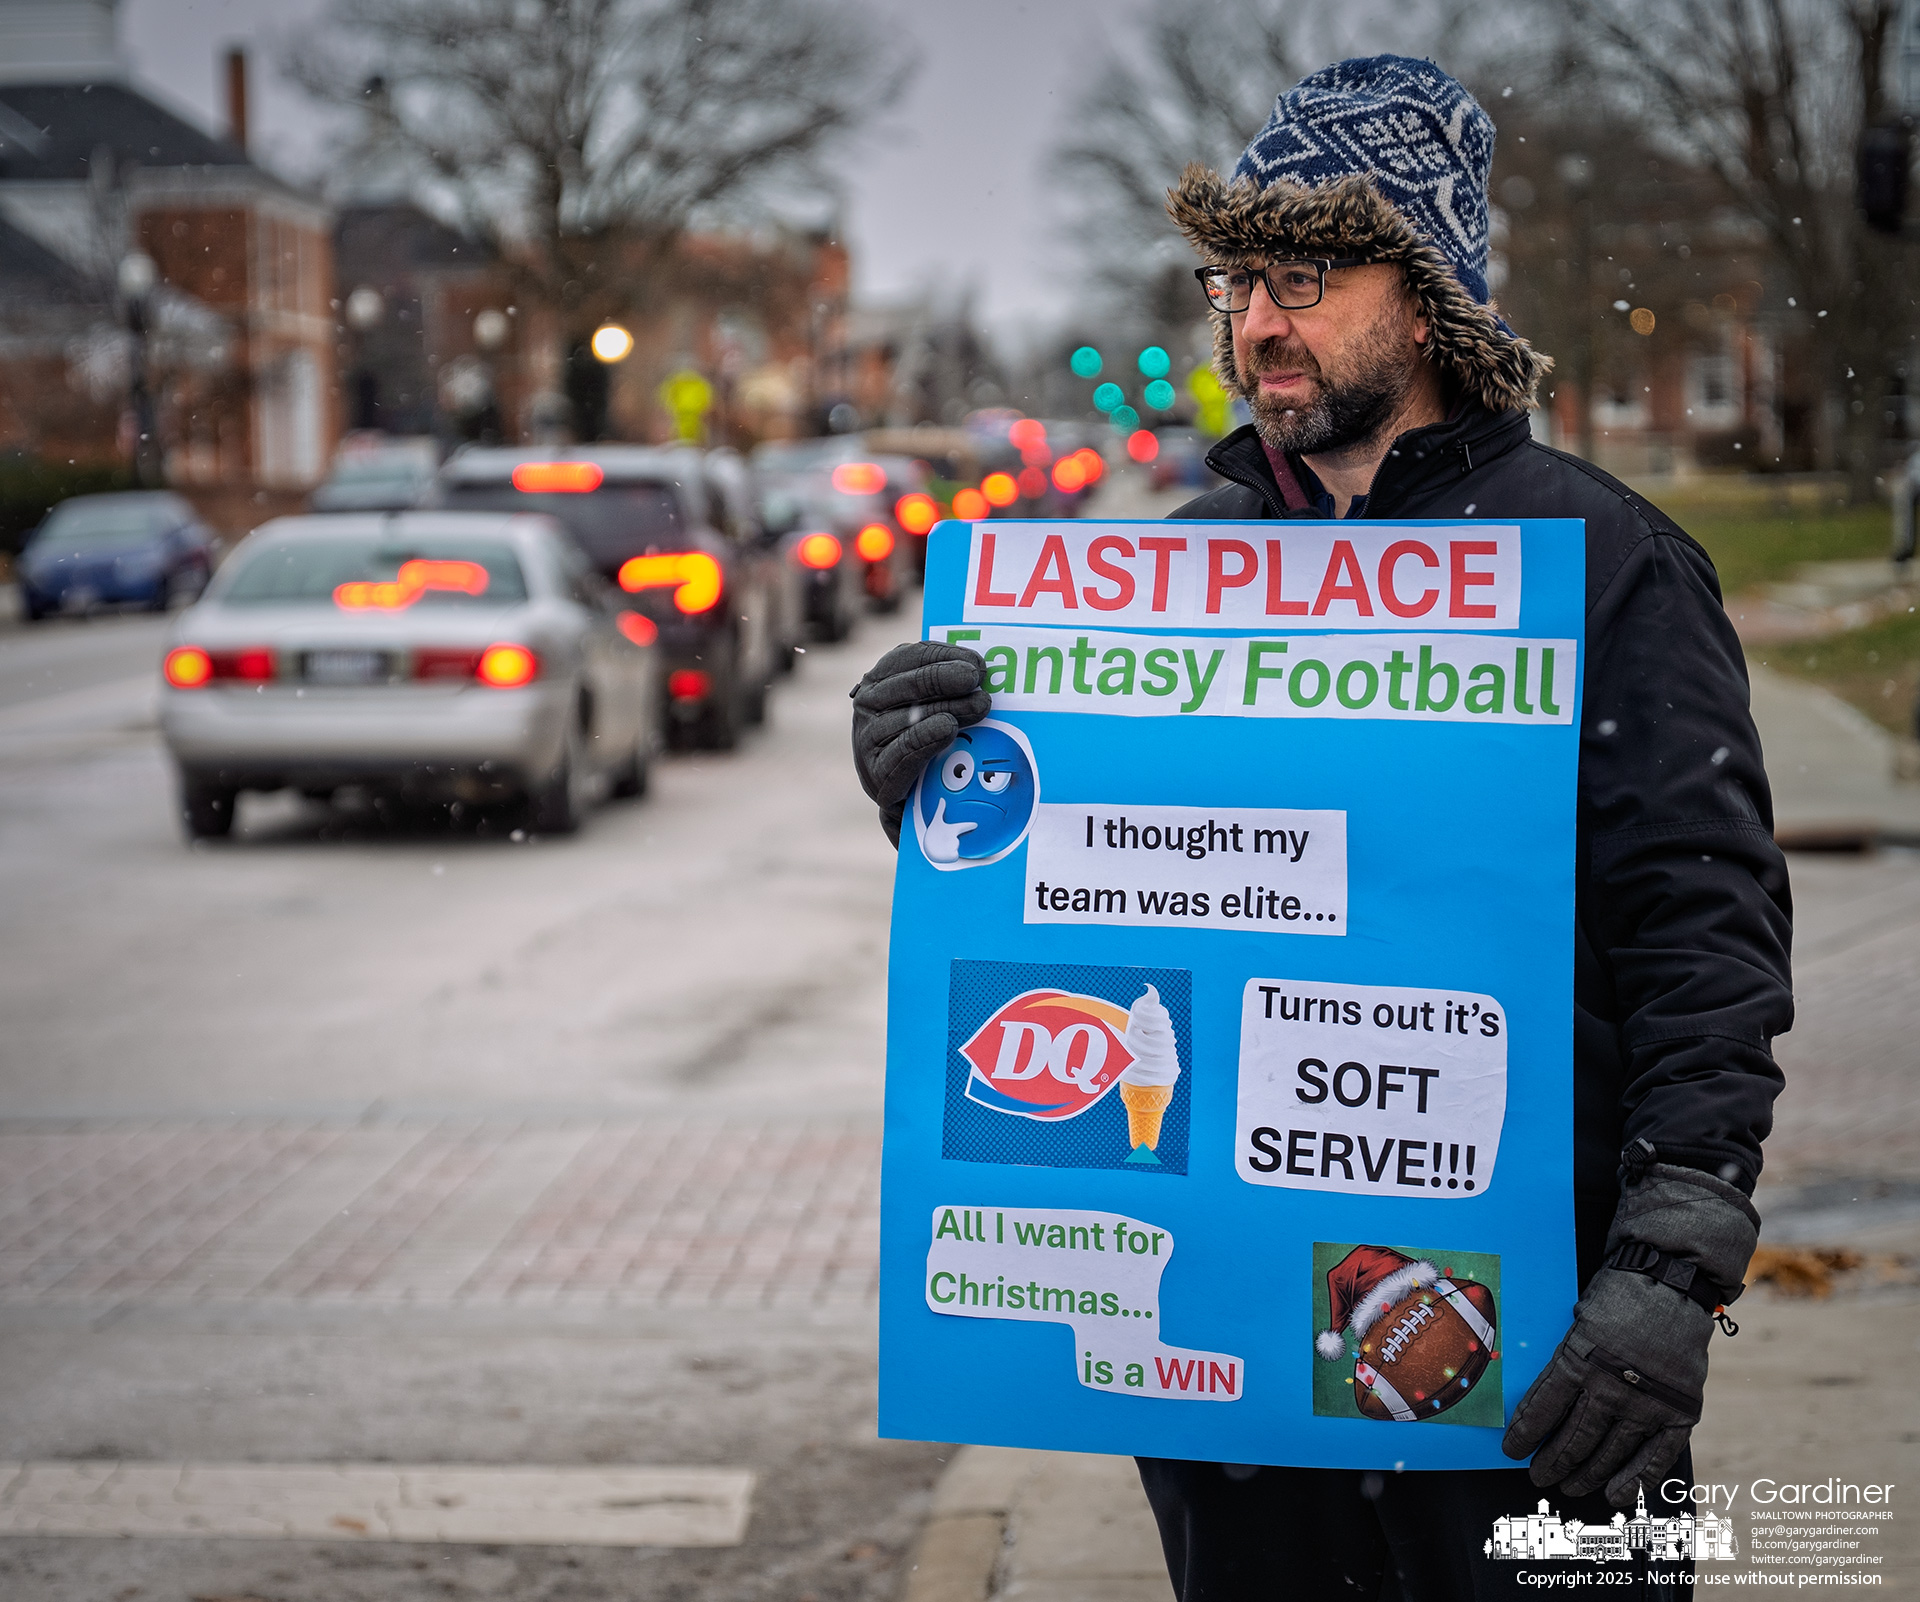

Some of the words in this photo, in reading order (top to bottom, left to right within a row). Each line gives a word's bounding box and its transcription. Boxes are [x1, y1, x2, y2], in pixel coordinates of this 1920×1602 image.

[974, 533, 1187, 612] LAST
[1205, 538, 1498, 619] PLACE
[1243, 641, 1560, 715] Football
[1086, 815, 1094, 848] I
[1103, 816, 1244, 860] thought
[1254, 829, 1310, 863] my
[1035, 881, 1127, 914] team
[1137, 890, 1210, 917] was
[1220, 886, 1337, 922] elite...
[1258, 985, 1362, 1026] Turns
[1373, 999, 1435, 1032] out
[991, 1020, 1109, 1094] DQ
[1295, 1057, 1440, 1114] SOFT
[1248, 1126, 1477, 1191] SERVE!!!
[936, 1209, 985, 1243] All
[996, 1212, 1004, 1243] I
[1013, 1220, 1106, 1252] want
[1112, 1221, 1165, 1256] for
[929, 1270, 1154, 1319] Christmas...
[1084, 1351, 1114, 1384] is
[1124, 1362, 1145, 1387] a
[1154, 1356, 1237, 1395] WIN
